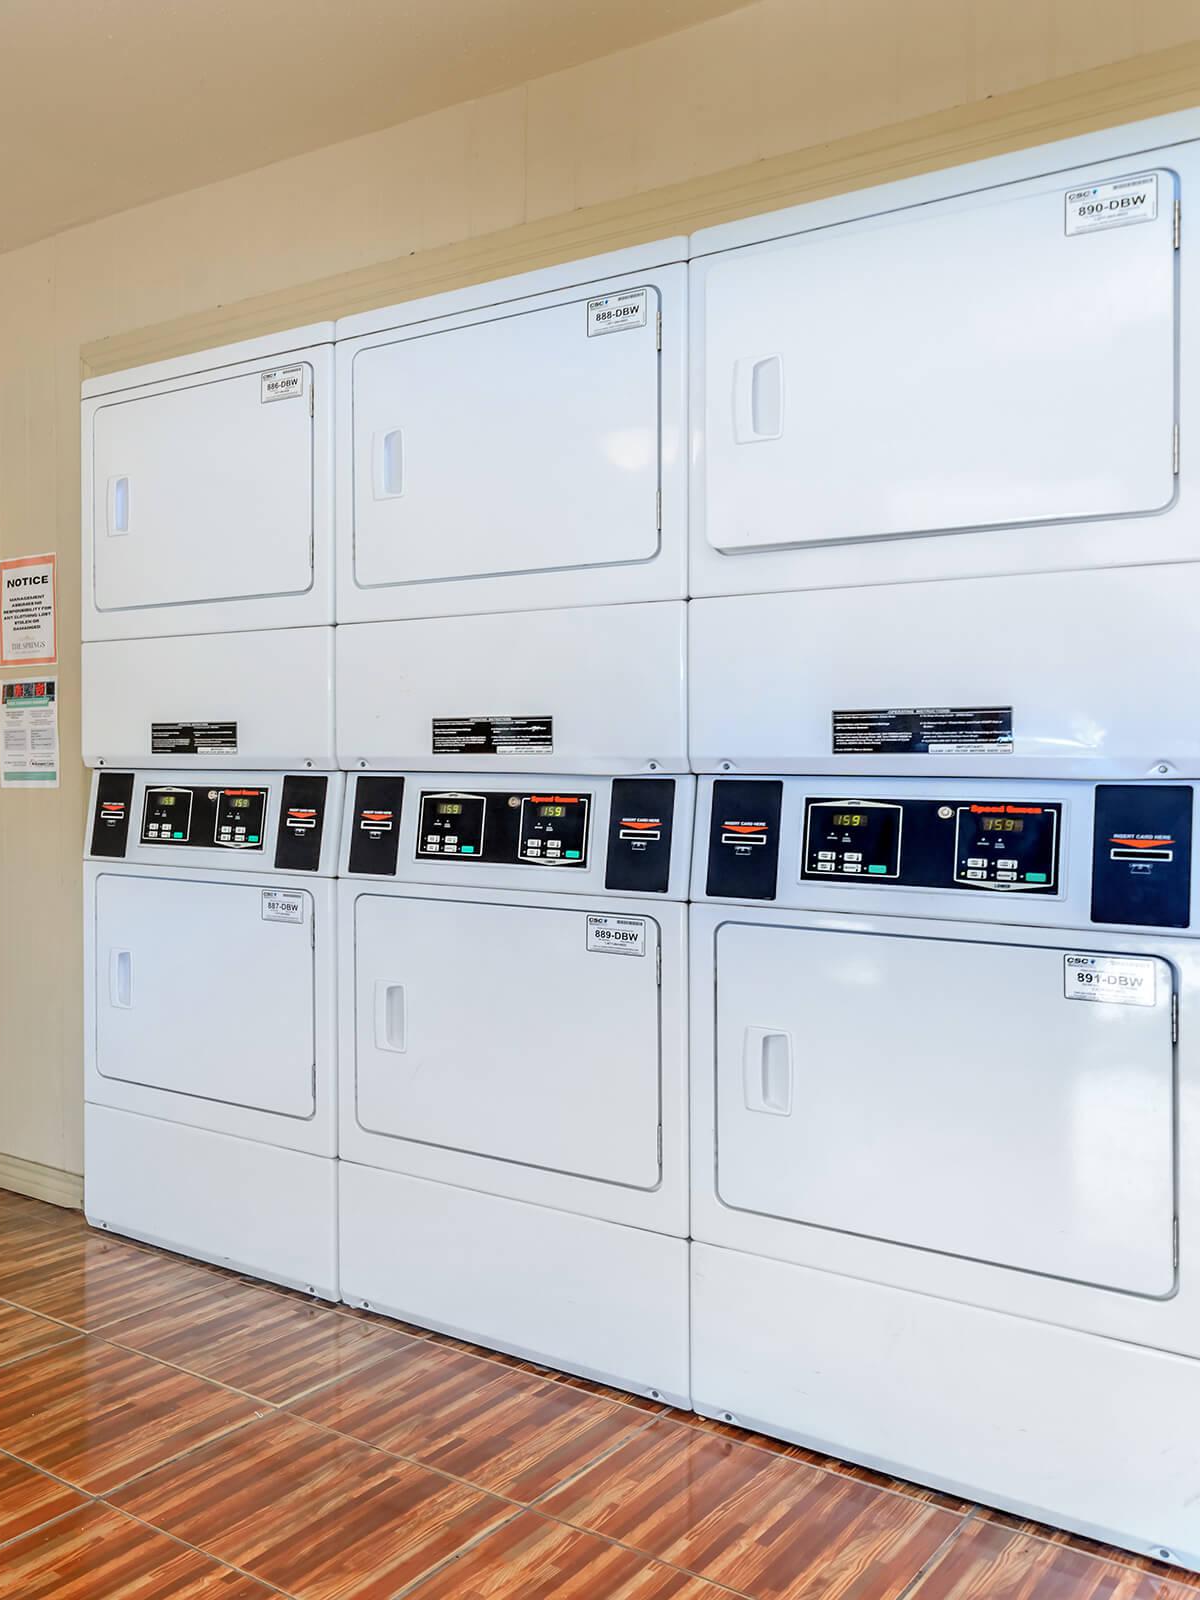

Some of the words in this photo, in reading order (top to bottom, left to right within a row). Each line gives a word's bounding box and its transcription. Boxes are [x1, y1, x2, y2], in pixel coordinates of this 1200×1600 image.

[1077, 194, 1147, 217] 890-DBW
[595, 305, 640, 321] 888-DBW
[6, 575, 49, 588] NOTICE
[838, 815, 861, 826] 159
[988, 819, 1014, 831] 159
[594, 929, 639, 942] 889-DBW
[1066, 957, 1089, 965] CSC
[1076, 972, 1144, 988] 891-DBW
